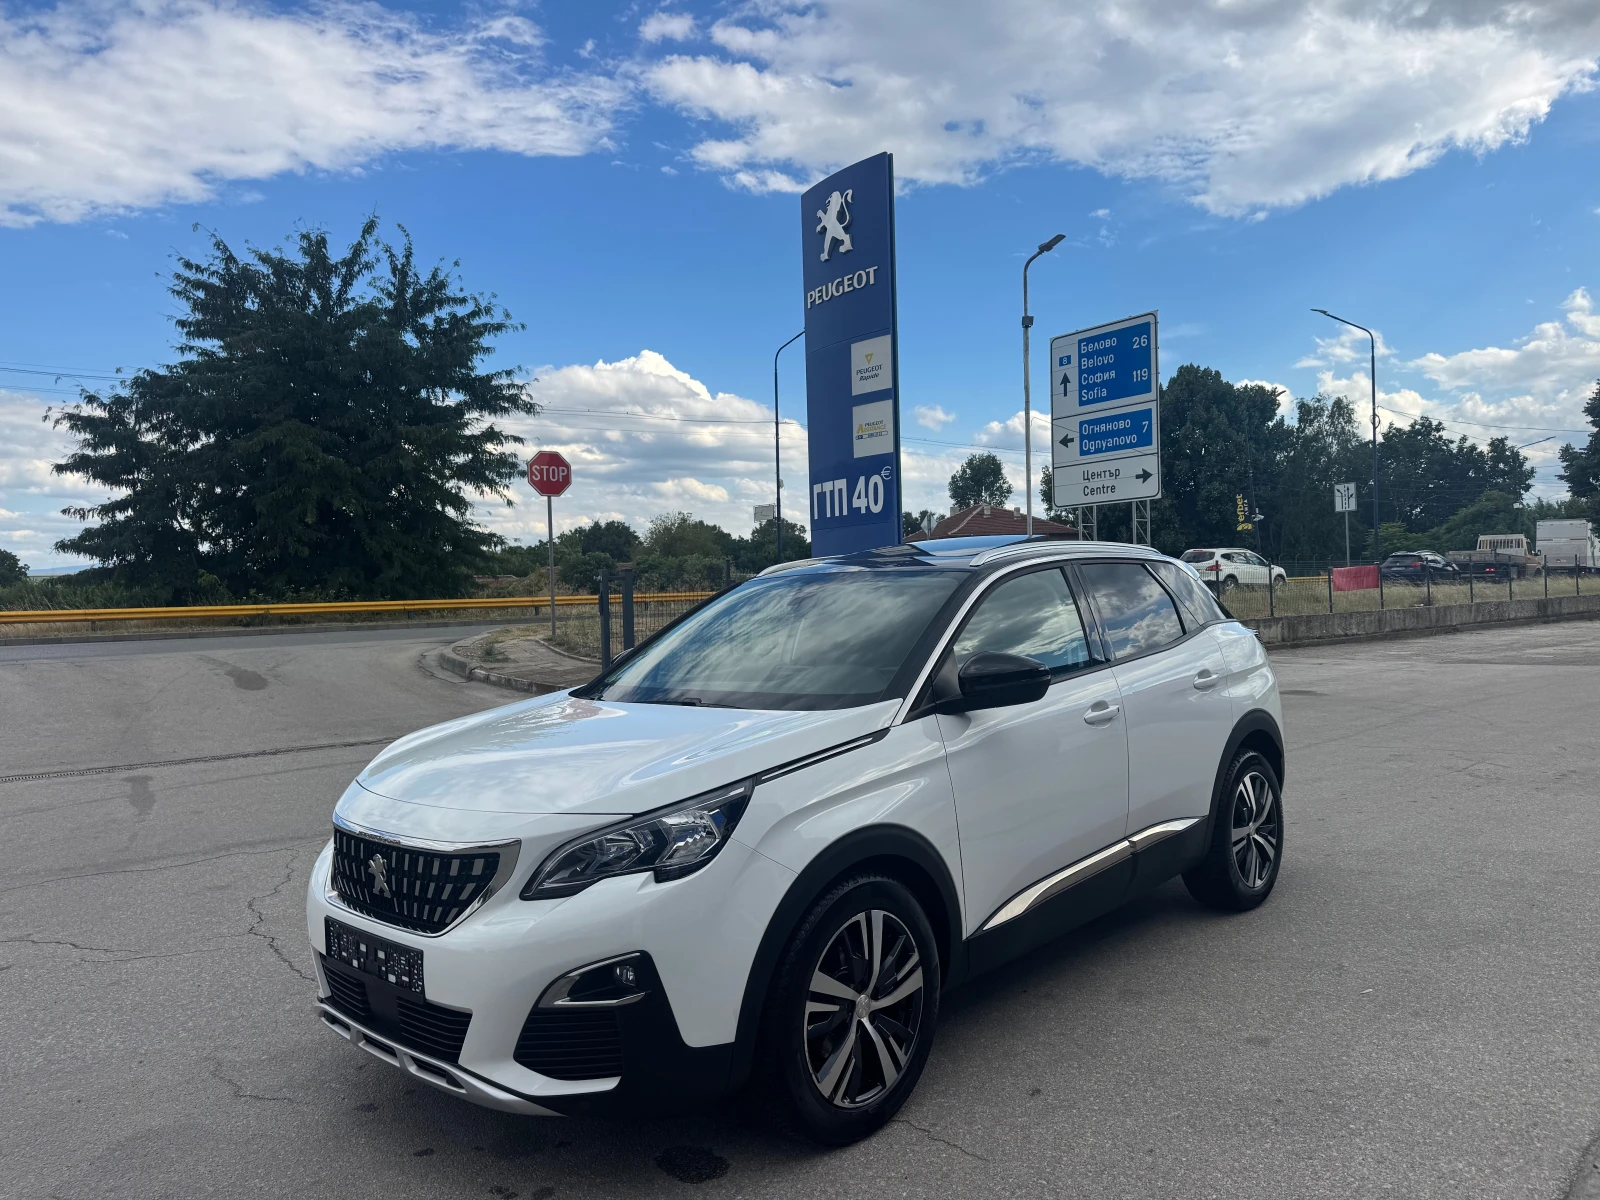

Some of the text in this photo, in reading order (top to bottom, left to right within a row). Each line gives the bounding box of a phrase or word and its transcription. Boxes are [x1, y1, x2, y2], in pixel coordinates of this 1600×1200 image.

[807, 265, 879, 309] PEUGEOT
[1080, 334, 1148, 353] Белово 26
[1062, 357, 1068, 365] 8
[1081, 354, 1115, 369] Belovo
[856, 364, 882, 375] PEUGEOT
[859, 372, 880, 381] Rapide
[1081, 368, 1148, 385] София 119
[1081, 387, 1107, 401] Sofia
[1082, 419, 1149, 435] Огняново 7
[1082, 433, 1138, 452] Ognyanovo
[532, 465, 567, 482] STOP
[1082, 467, 1121, 482] Център
[1083, 484, 1116, 497] Centre
[813, 478, 848, 520] ГТП
[1236, 494, 1244, 522] efbet
